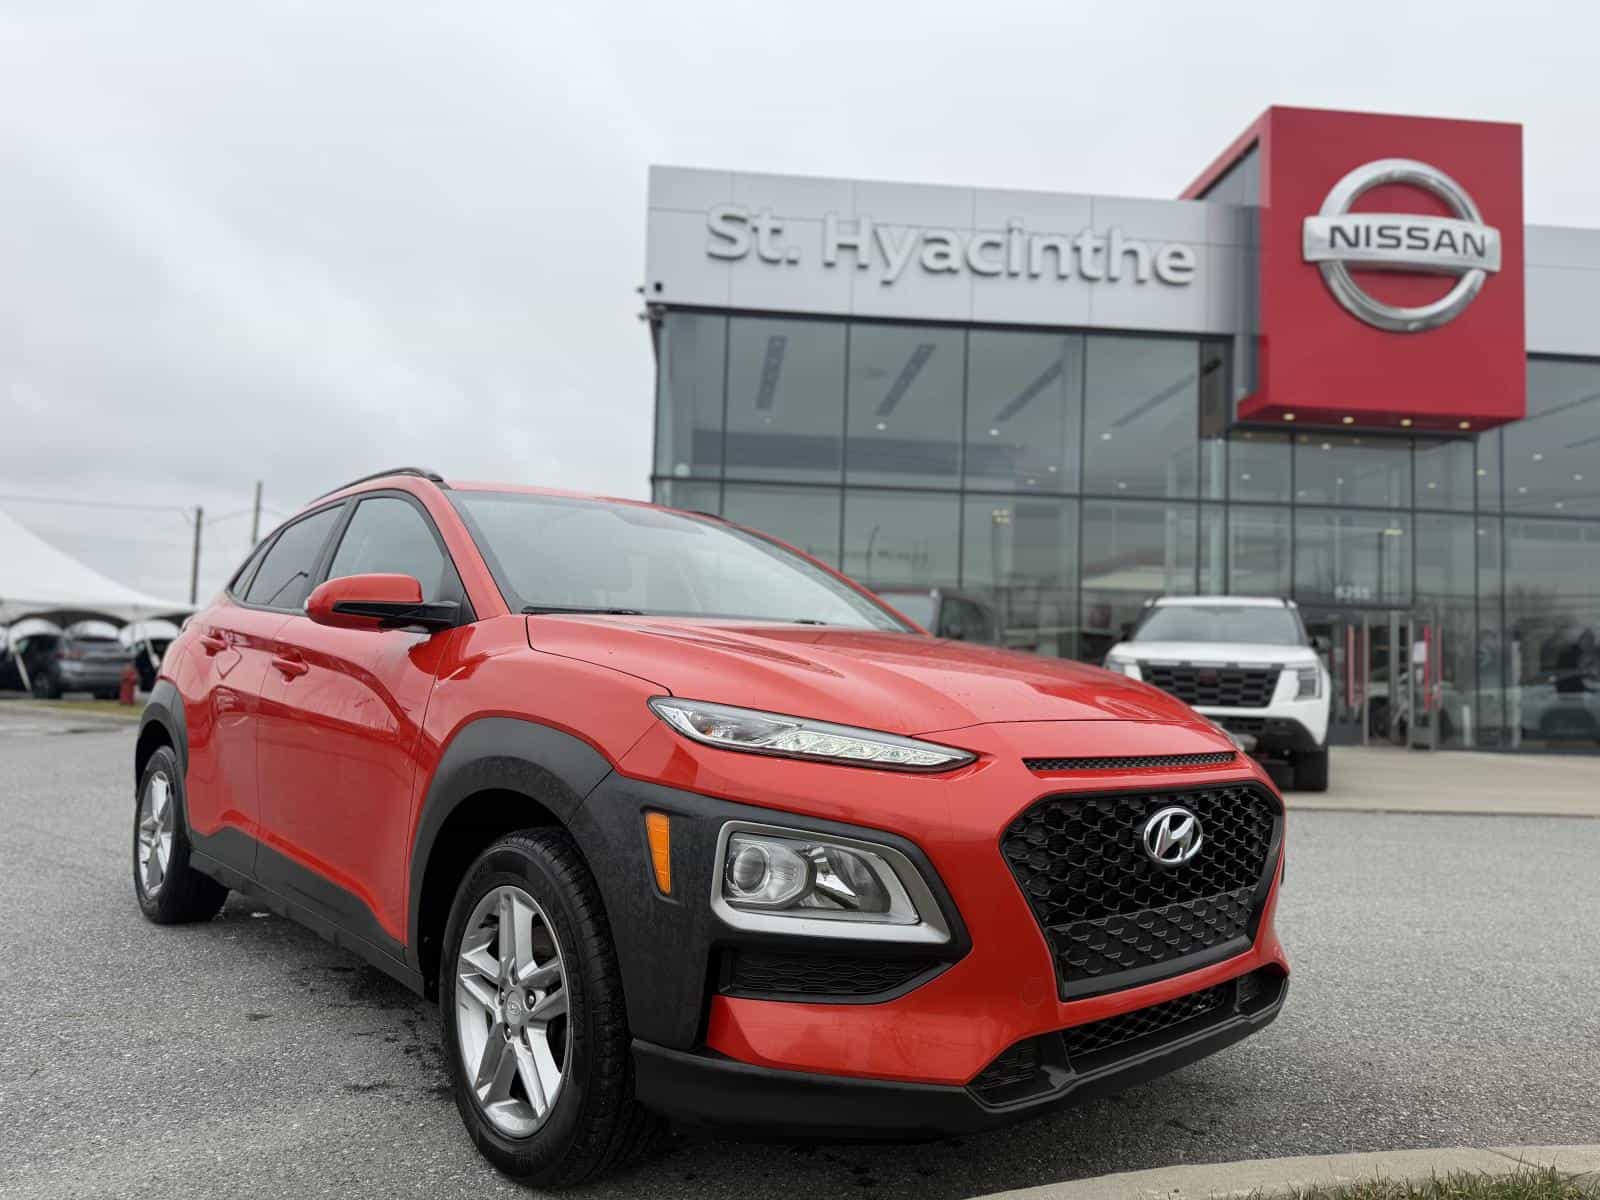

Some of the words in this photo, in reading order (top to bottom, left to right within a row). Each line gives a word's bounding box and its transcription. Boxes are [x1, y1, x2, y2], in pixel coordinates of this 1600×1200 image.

[706, 203, 799, 262] St.
[822, 211, 1197, 286] Hyacinthe
[1329, 225, 1488, 258] NISSAN
